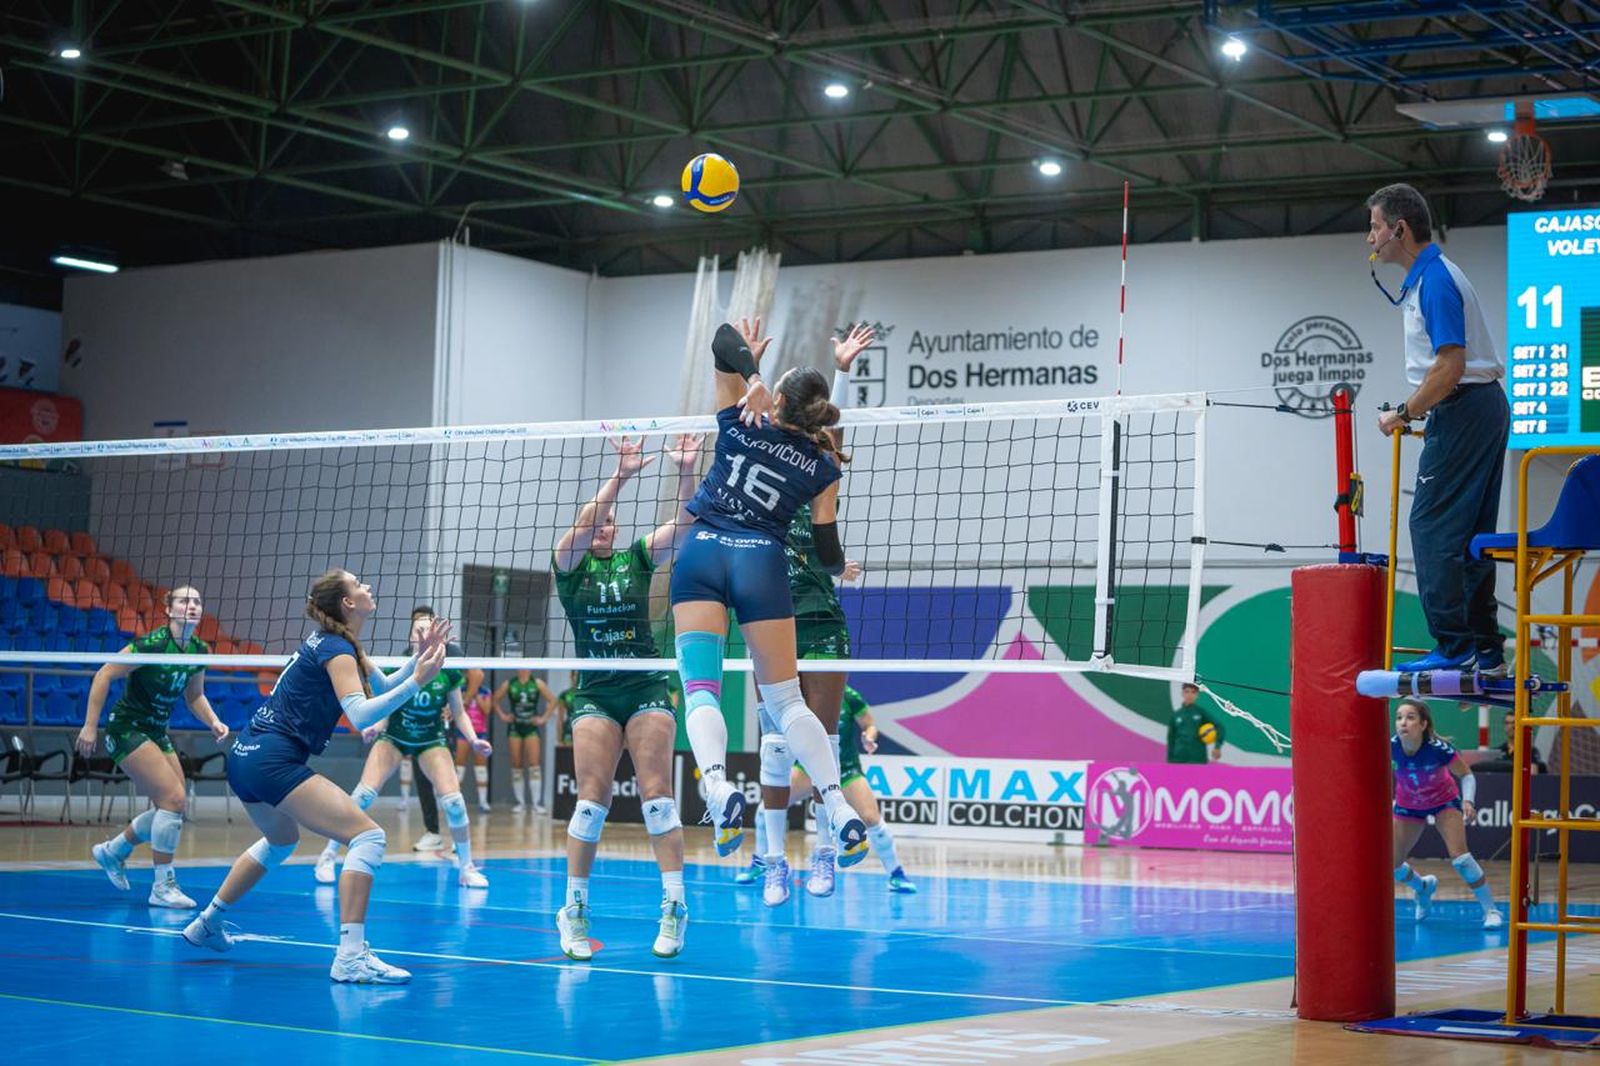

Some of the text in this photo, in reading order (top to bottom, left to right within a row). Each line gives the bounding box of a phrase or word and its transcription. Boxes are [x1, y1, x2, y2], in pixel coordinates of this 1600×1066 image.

[1547, 238, 1600, 256] VOLE
[1517, 284, 1562, 329] 11
[908, 324, 1099, 360] Ayuntamiento de
[1512, 344, 1567, 360] SET 1 21
[1261, 351, 1374, 368] Dos Hermanas
[908, 362, 1098, 389] Dos Hermanas
[1273, 364, 1366, 386] juega limpio
[1512, 364, 1537, 379] SET
[1537, 363, 1547, 378] 2
[1512, 382, 1538, 397] SET
[1079, 401, 1100, 410] CEV
[1512, 401, 1547, 415] SET 4
[1512, 420, 1538, 434] SET
[725, 453, 788, 511] 16
[596, 580, 622, 604] 11
[592, 626, 636, 646] Cajasol
[171, 671, 187, 691] 14
[557, 773, 641, 797] Fuaci
[866, 766, 937, 798] AX
[950, 768, 1085, 804] MAX
[949, 802, 1084, 829] COLCHON
